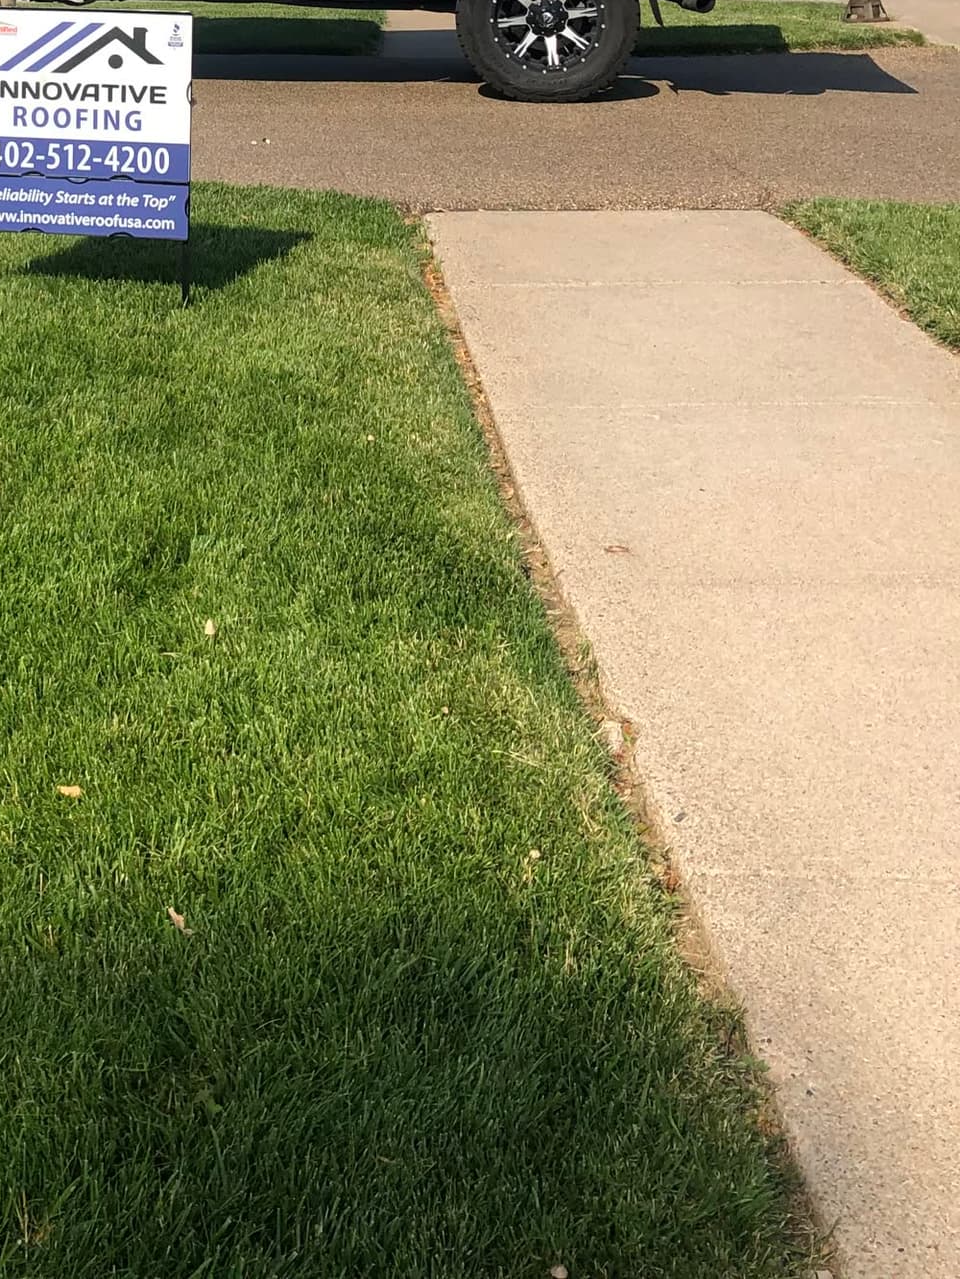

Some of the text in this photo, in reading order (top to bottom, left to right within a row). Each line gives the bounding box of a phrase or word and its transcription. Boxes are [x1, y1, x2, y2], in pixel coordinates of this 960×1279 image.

[13, 106, 143, 132] ROOFING
[55, 190, 96, 205] Starts
[98, 193, 114, 207] at
[116, 192, 140, 207] the
